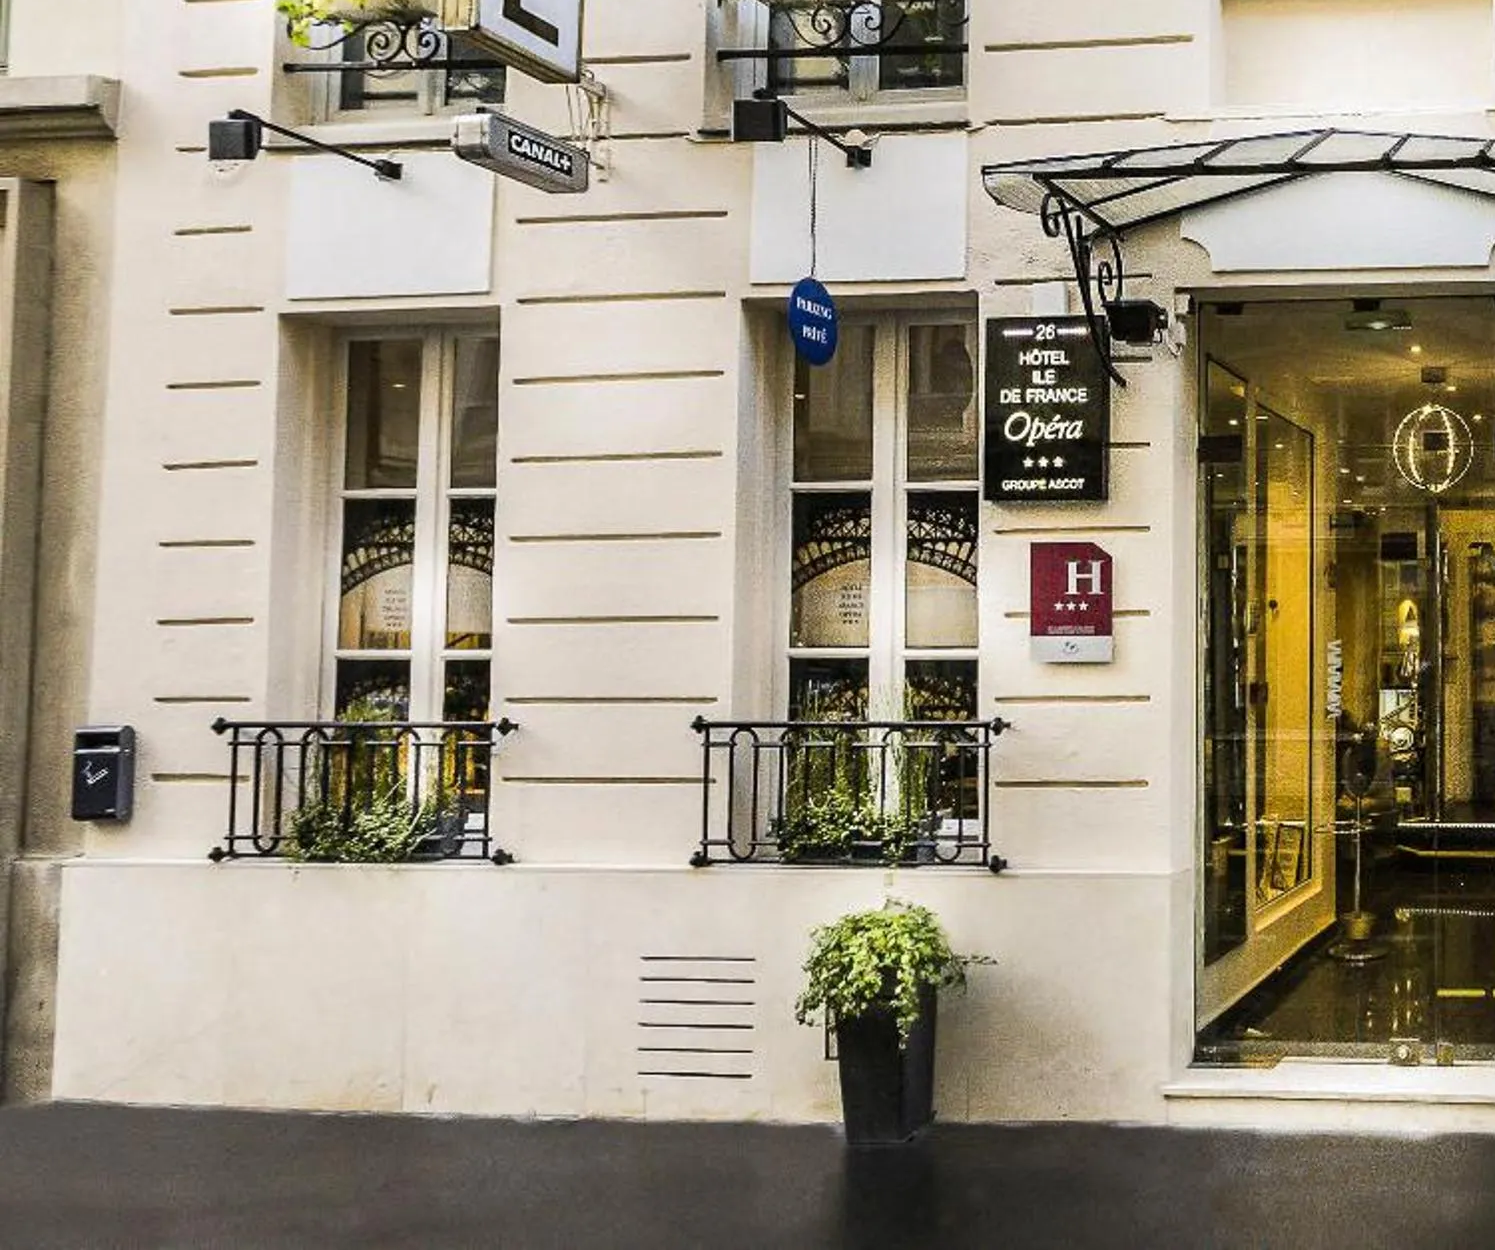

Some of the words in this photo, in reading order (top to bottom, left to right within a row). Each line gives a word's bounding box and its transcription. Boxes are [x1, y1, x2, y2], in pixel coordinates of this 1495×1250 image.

[510, 134, 571, 170] CANAL+
[1035, 324, 1055, 340] 26
[1018, 348, 1070, 366] HÔTEL
[1032, 369, 1057, 385] ILE
[1000, 388, 1022, 404] DE
[1025, 388, 1089, 404] FRANCE
[1003, 410, 1084, 447] Opéra
[1001, 478, 1047, 491] GROUPE
[1047, 477, 1085, 490] ASCOT
[1064, 559, 1105, 595] H
